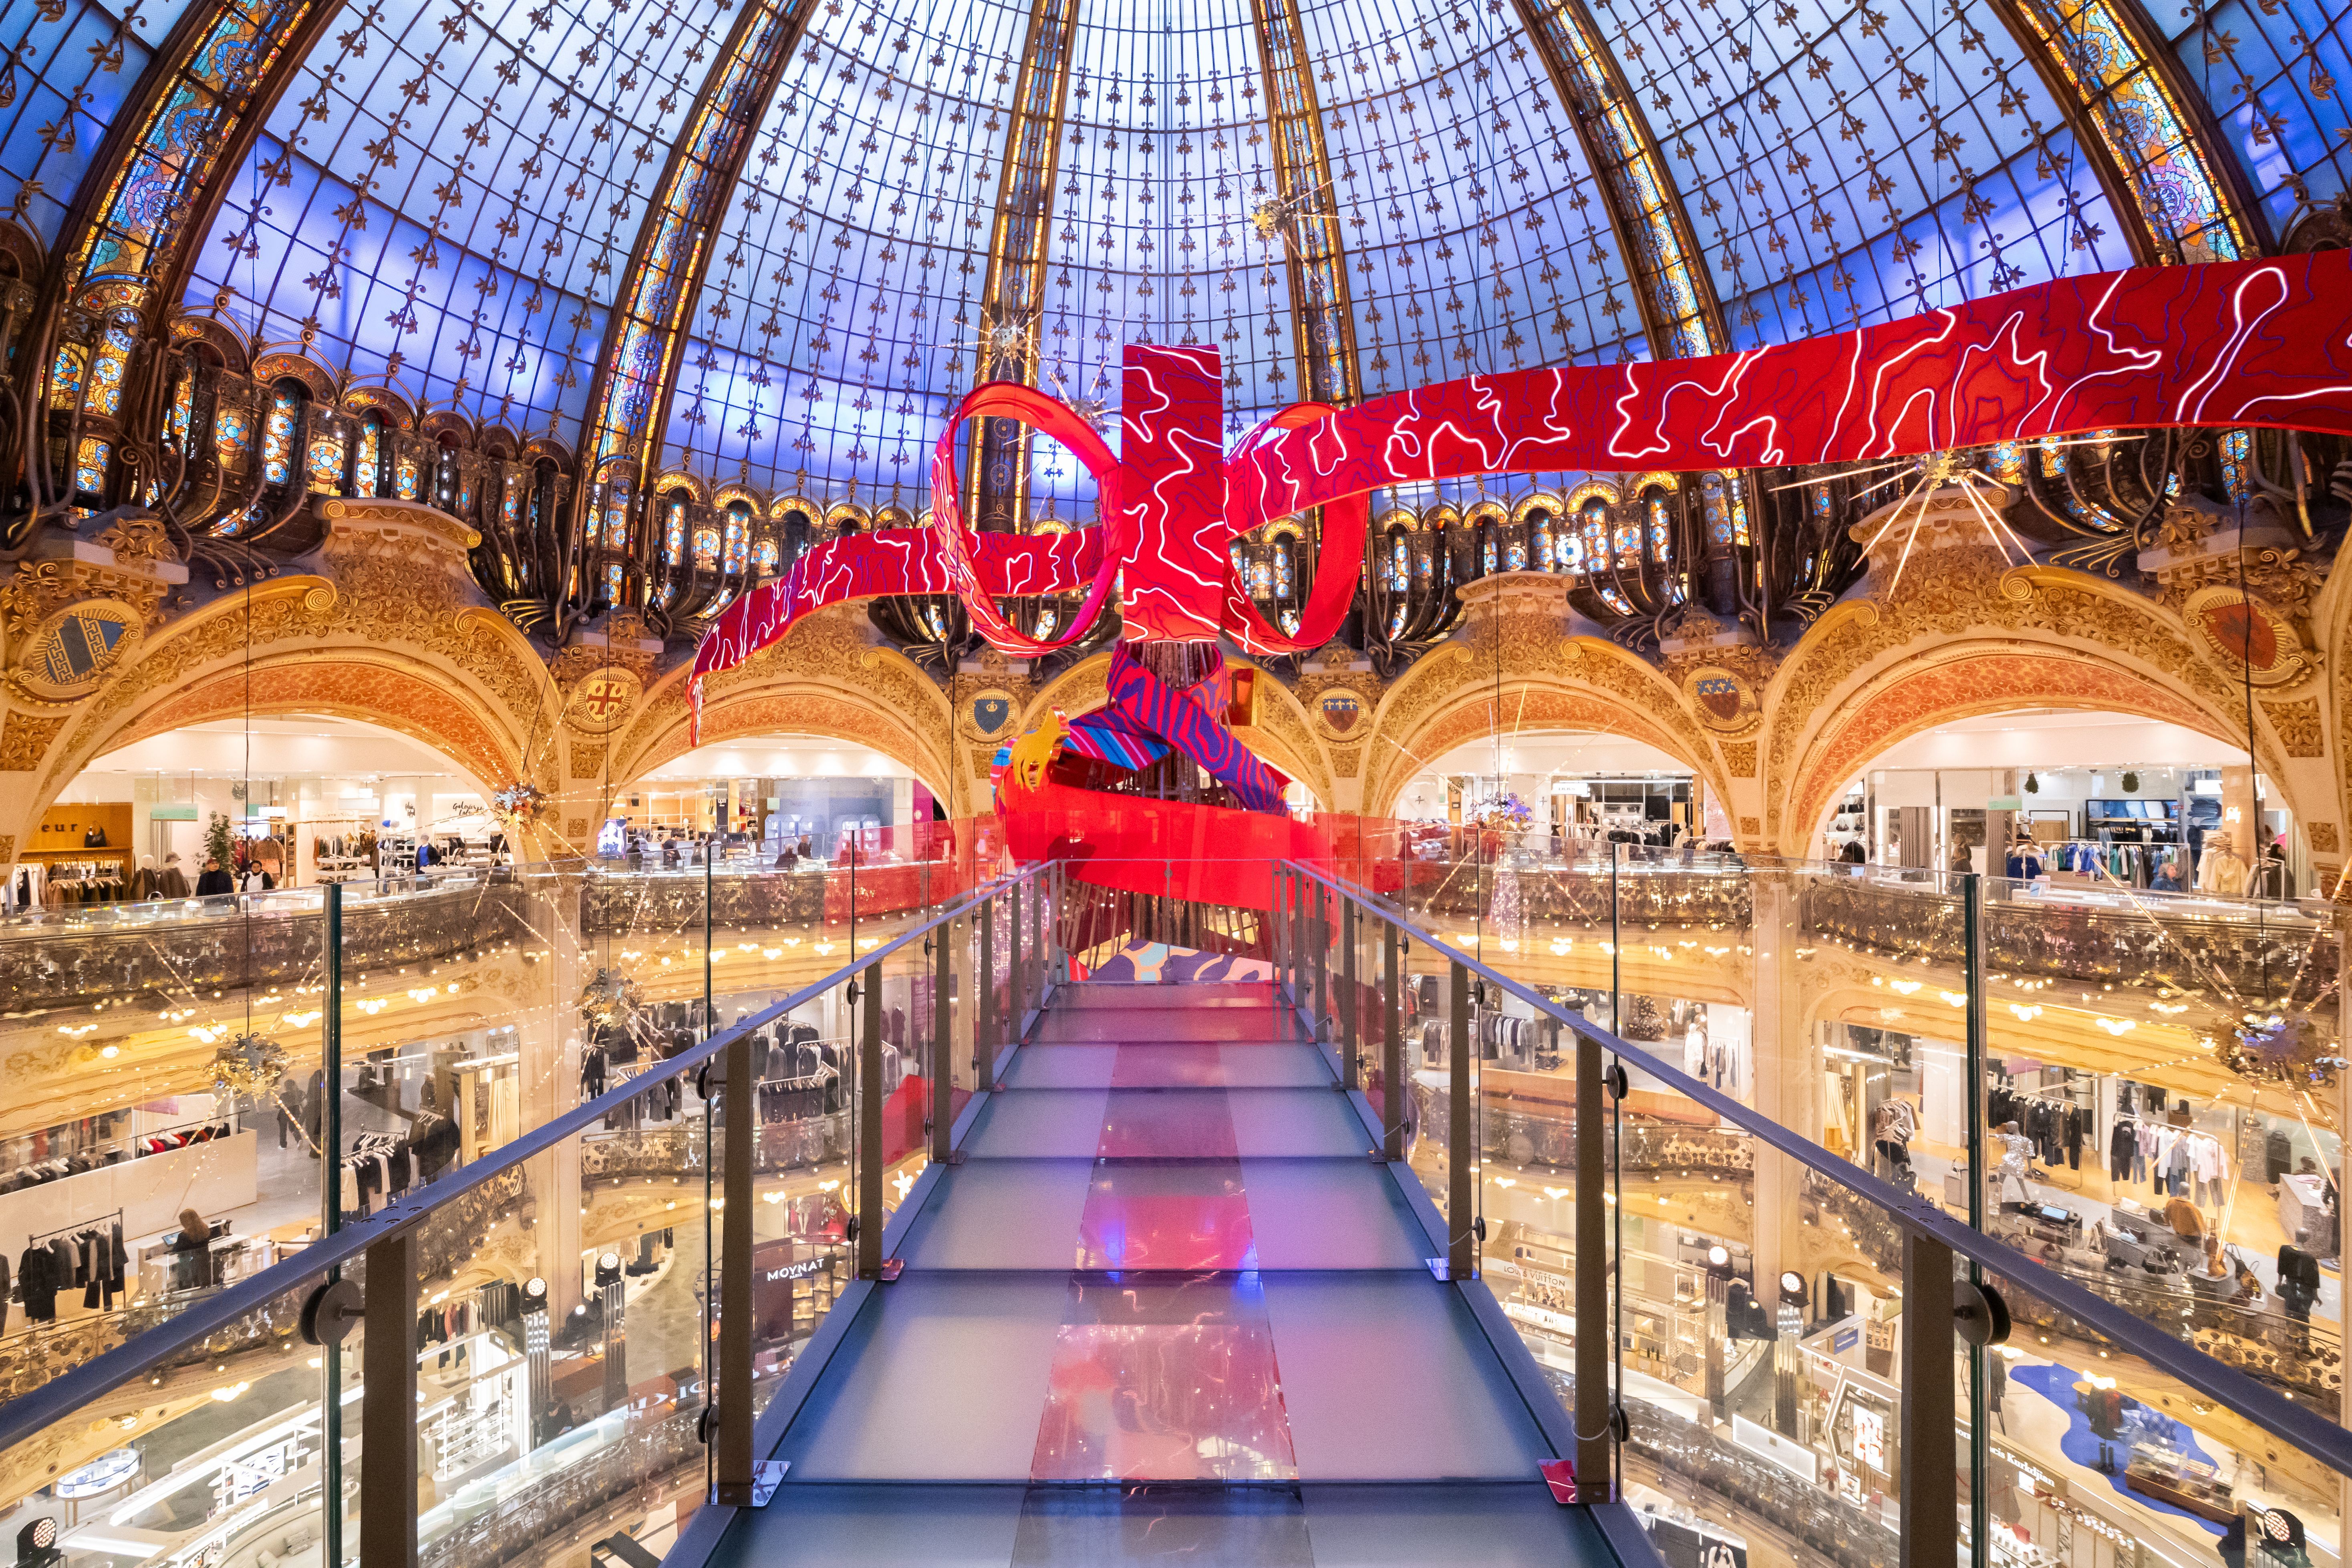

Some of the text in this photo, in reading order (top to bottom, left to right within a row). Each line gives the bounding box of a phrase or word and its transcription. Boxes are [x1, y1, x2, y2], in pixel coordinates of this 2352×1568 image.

[767, 1258, 824, 1281] MOYNAT
[1530, 1272, 1565, 1286] VUITTON
[2007, 1452, 2055, 1487] Kurkdjian
